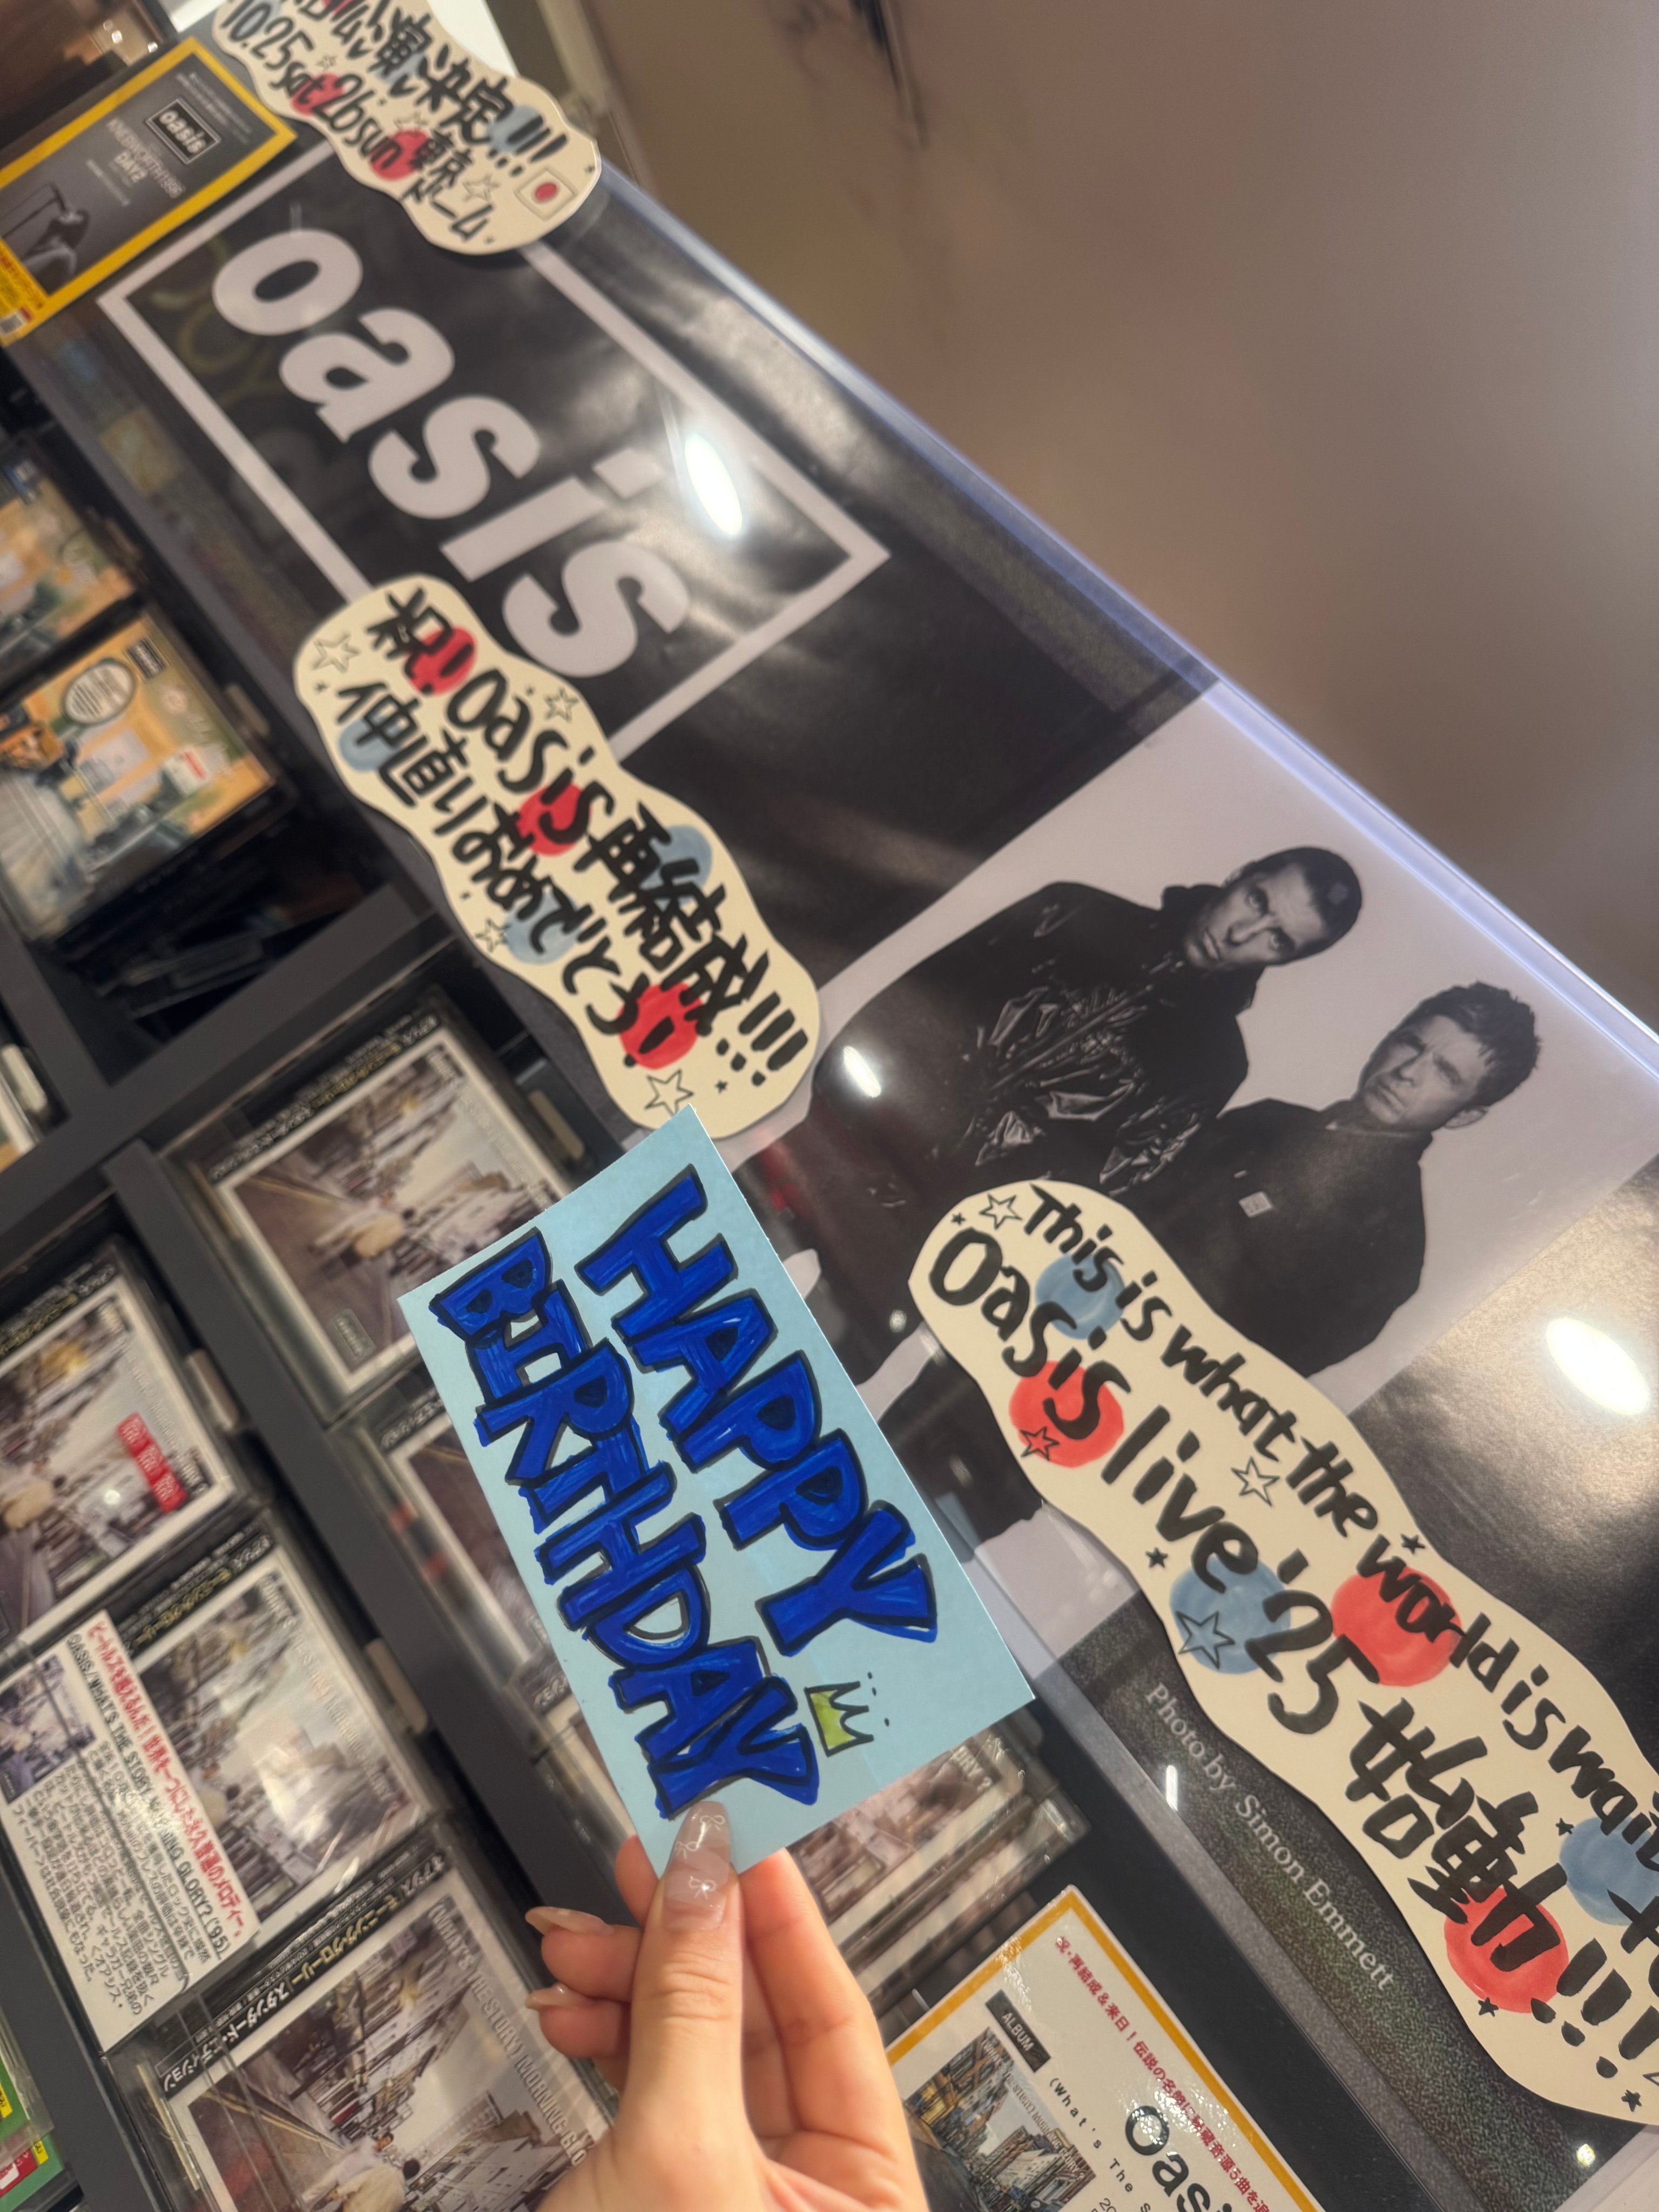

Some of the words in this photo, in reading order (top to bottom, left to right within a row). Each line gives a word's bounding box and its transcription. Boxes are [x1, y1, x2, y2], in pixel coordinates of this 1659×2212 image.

[160, 110, 208, 153] oasis
[212, 229, 690, 677] oasis
[576, 1162, 938, 1656] HAPPY
[929, 1227, 1131, 1440] Oasis
[1101, 1406, 1258, 1593] live
[1024, 1183, 1124, 1292] This
[1115, 1270, 1172, 1341] is
[1161, 1325, 1297, 1462] what
[1285, 1436, 1379, 1538] the
[1355, 1534, 1520, 1692] world
[1501, 1664, 1566, 1750] is
[429, 1227, 819, 1819] BIRTHDAY
[110, 1725, 133, 1751] THE
[1147, 1682, 1205, 1758] Photo
[1203, 1754, 1236, 1792] by
[1235, 1793, 1305, 1883] Simon
[1303, 1878, 1394, 1991] Emmett
[463, 1968, 495, 2003] THE
[477, 1995, 528, 2060] STORY)
[1002, 2011, 1036, 2052] ALBUM
[511, 2055, 571, 2135] MORNING
[1109, 2158, 1132, 2192] The
